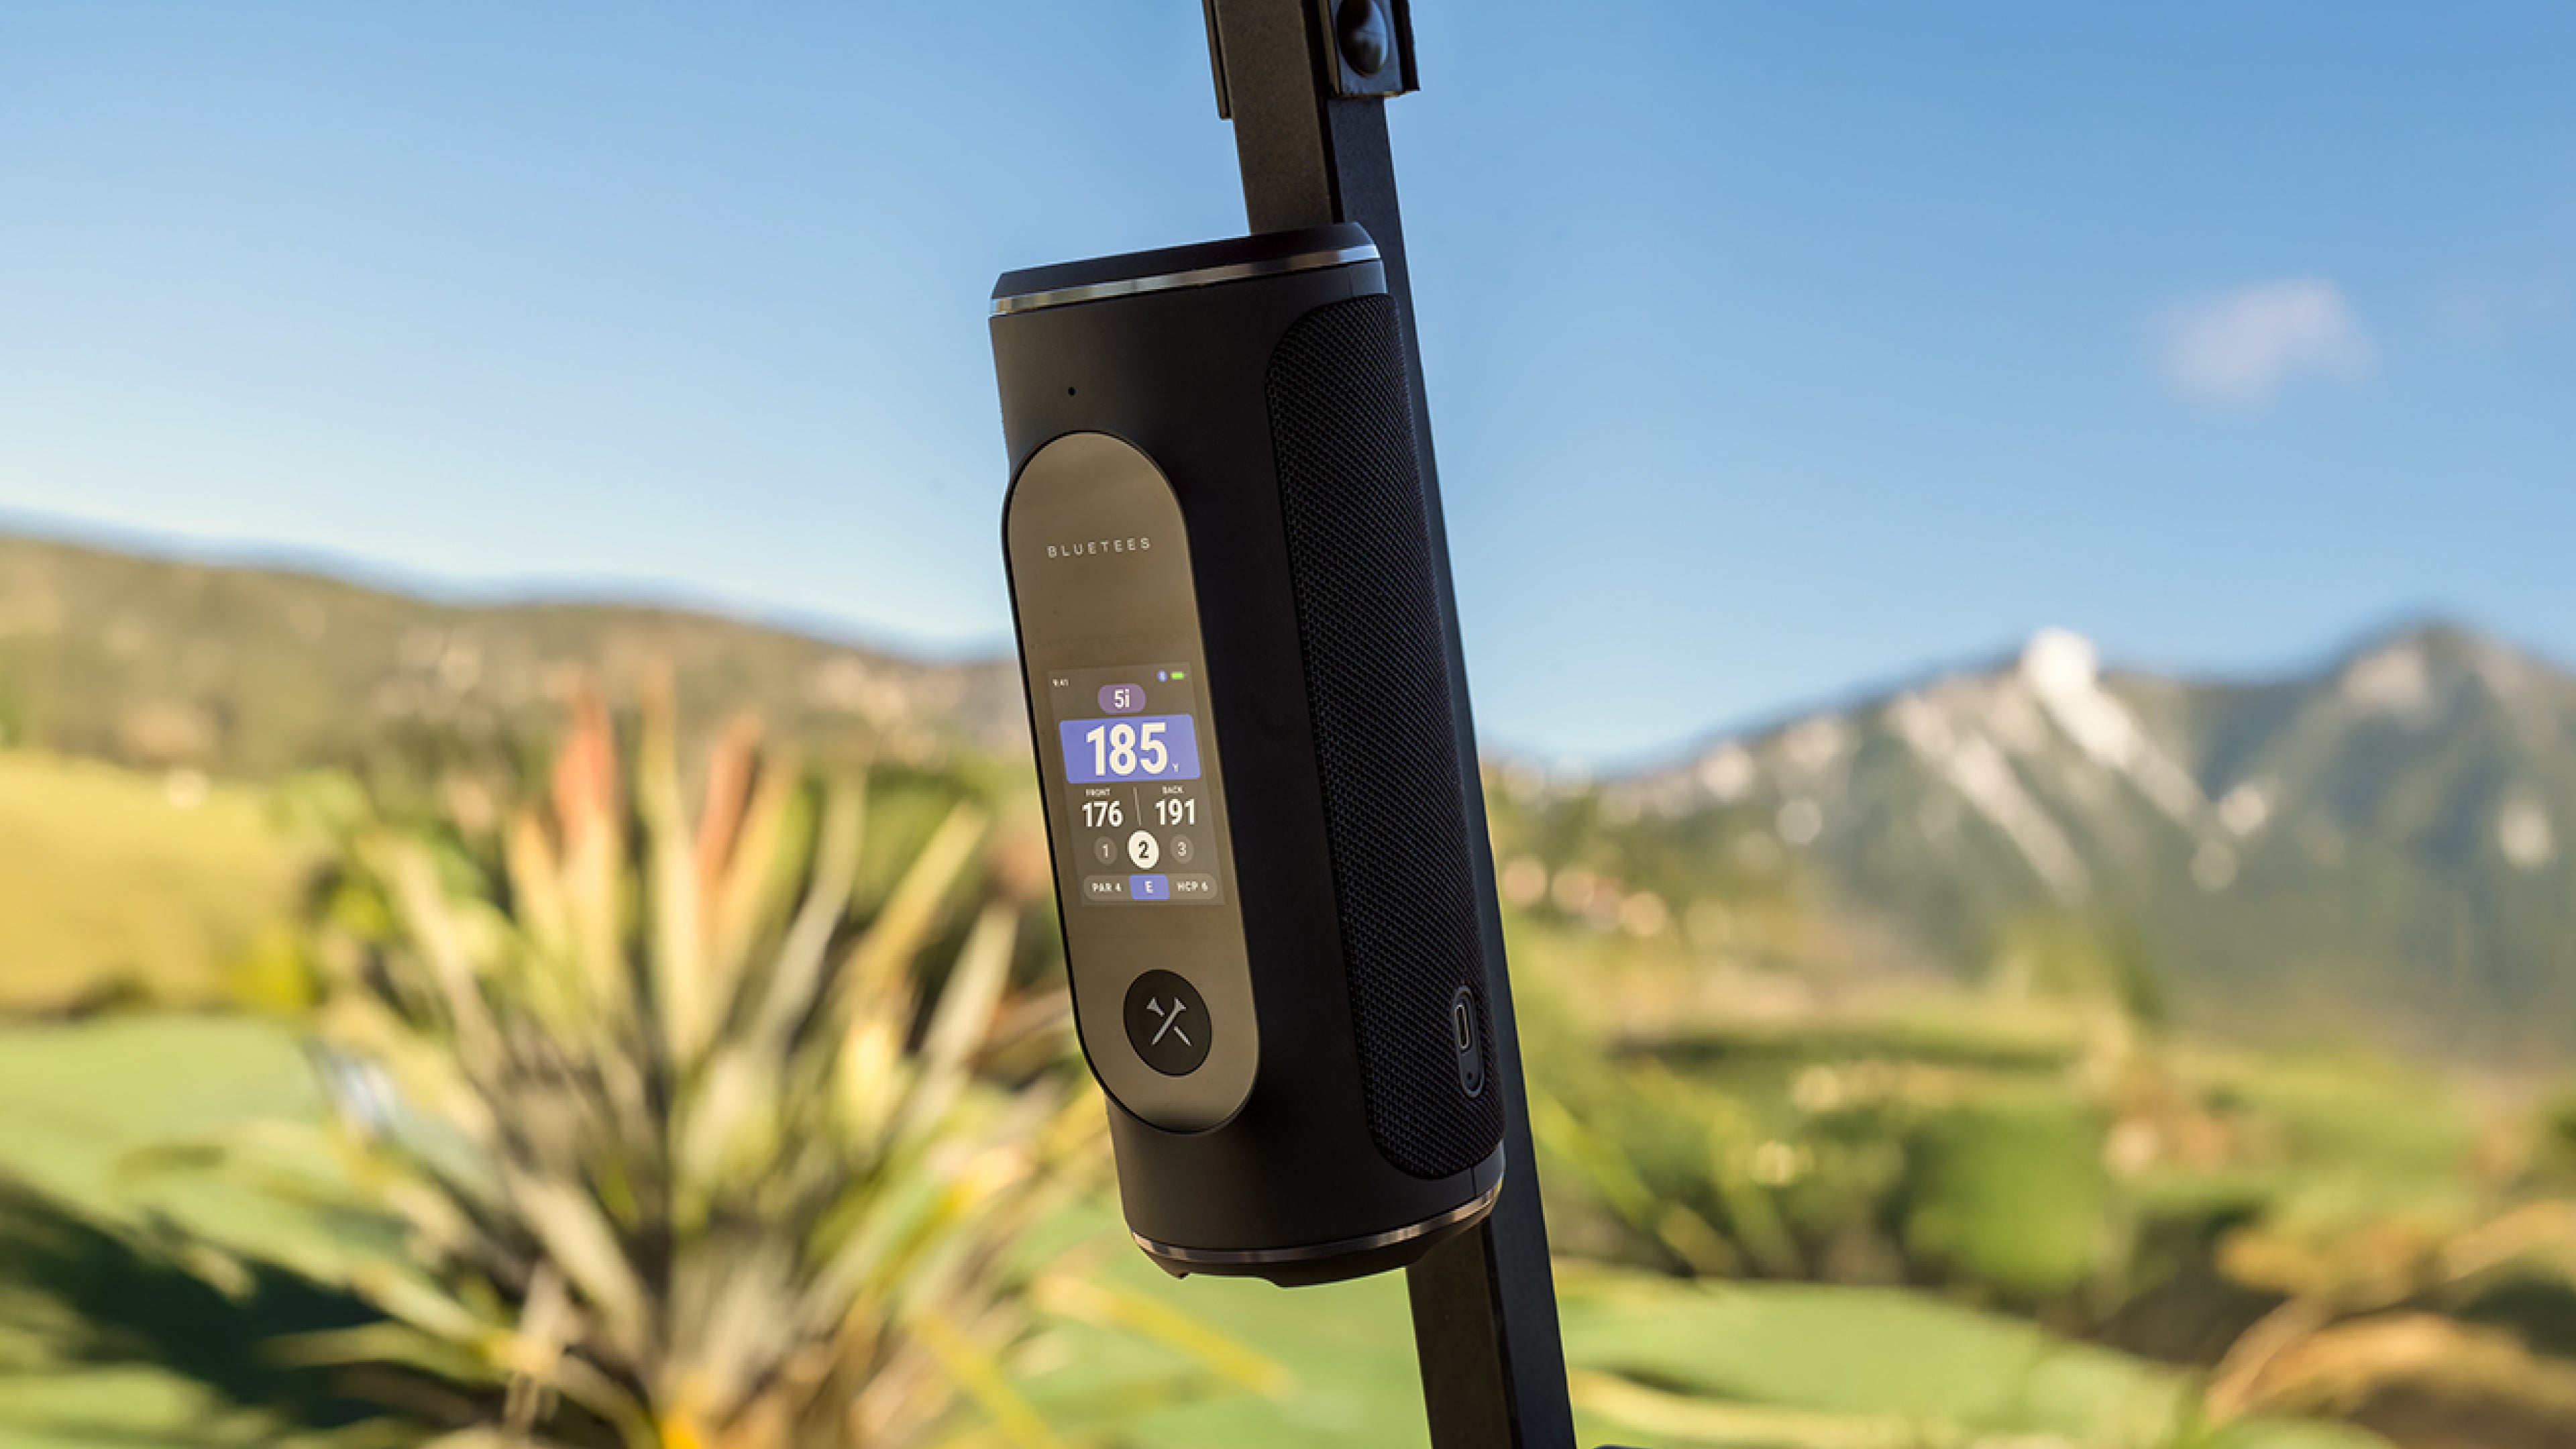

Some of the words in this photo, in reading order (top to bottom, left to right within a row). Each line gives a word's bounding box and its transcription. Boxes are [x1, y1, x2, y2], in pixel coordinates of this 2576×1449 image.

[1047, 537, 1150, 559] BLUETEES
[1114, 688, 1130, 709] 5i
[1085, 722, 1168, 777] 185
[1085, 788, 1111, 796] FRONT
[1161, 785, 1184, 794] BACK
[1081, 800, 1124, 827] 176
[1155, 798, 1195, 826] 191
[1102, 843, 1109, 859] 1
[1138, 840, 1150, 859] 2
[1177, 841, 1187, 857] 3
[1091, 883, 1112, 892] PAR
[1144, 881, 1154, 894] E
[1177, 881, 1199, 892] HCP
